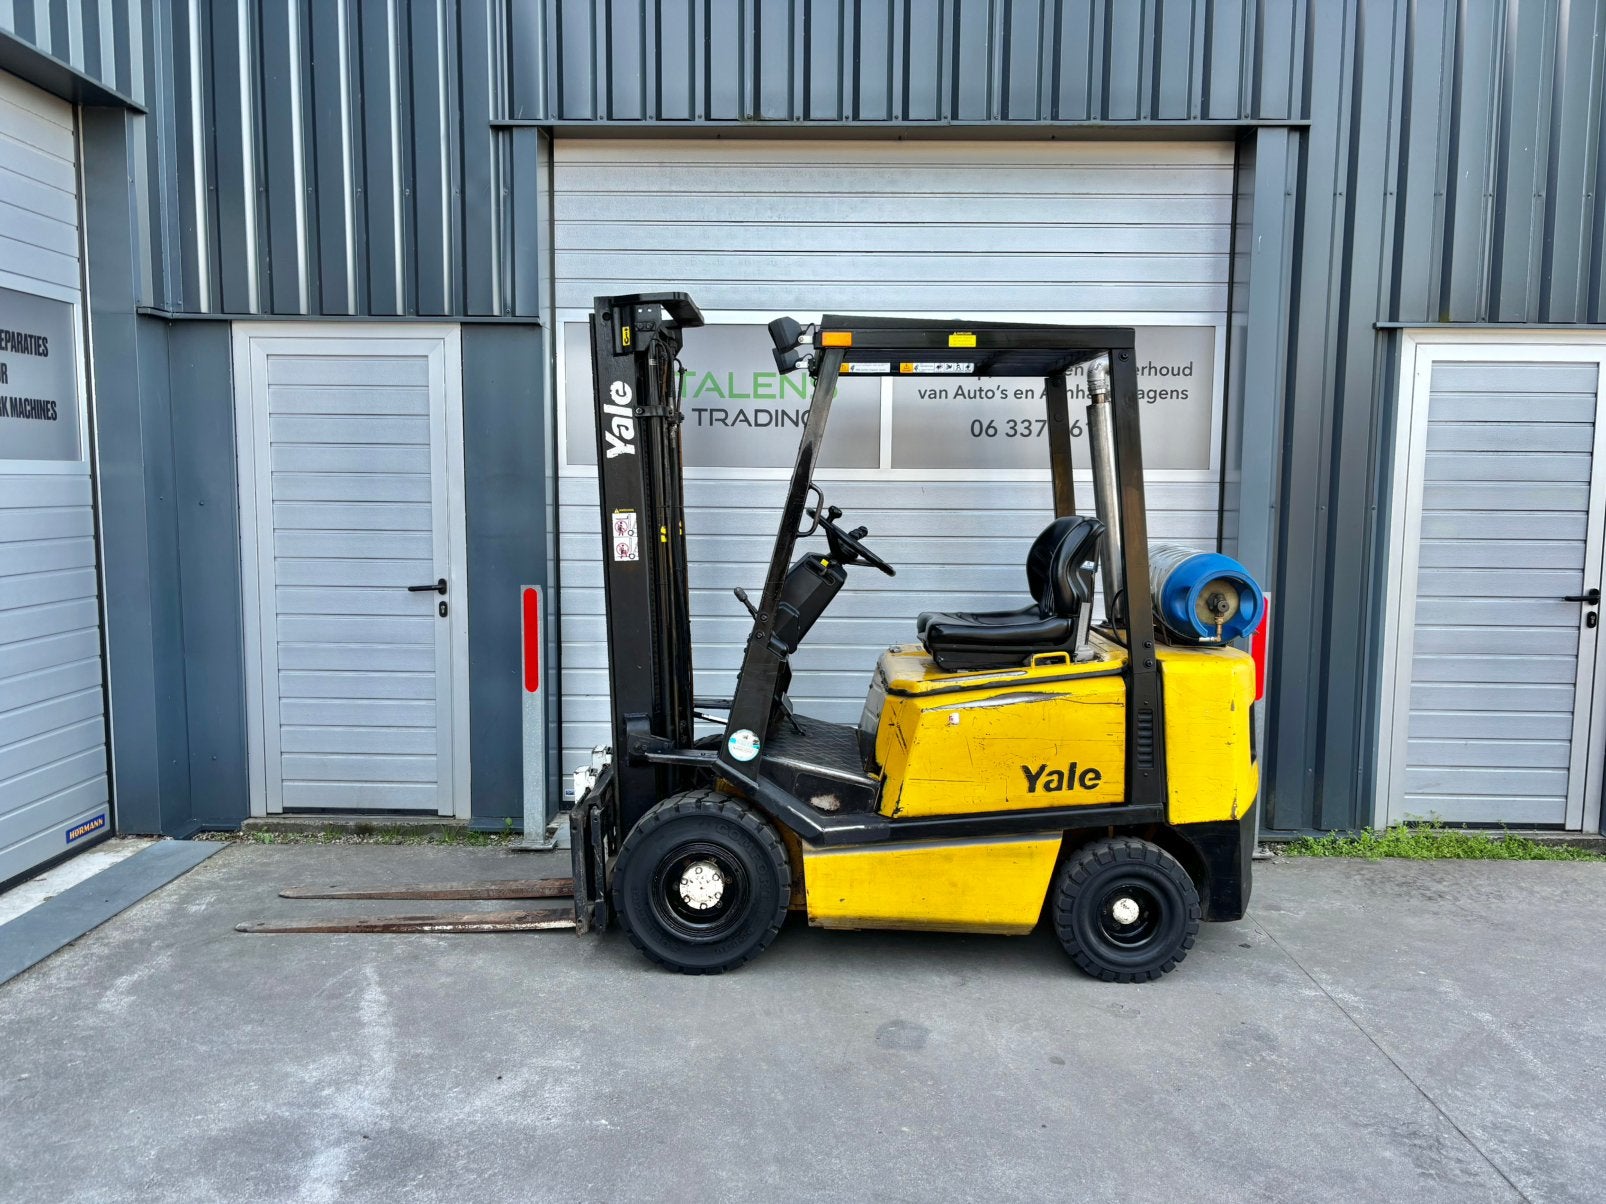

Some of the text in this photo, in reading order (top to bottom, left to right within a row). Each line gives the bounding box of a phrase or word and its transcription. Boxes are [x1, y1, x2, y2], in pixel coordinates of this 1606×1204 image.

[0, 362, 8, 384] R
[918, 388, 948, 399] van
[953, 385, 1008, 400] Auto's
[1014, 389, 1034, 399] en
[0, 395, 57, 421] K MACHINES
[603, 381, 636, 459] Yale
[971, 419, 997, 438] 06
[1021, 762, 1101, 793] Yale
